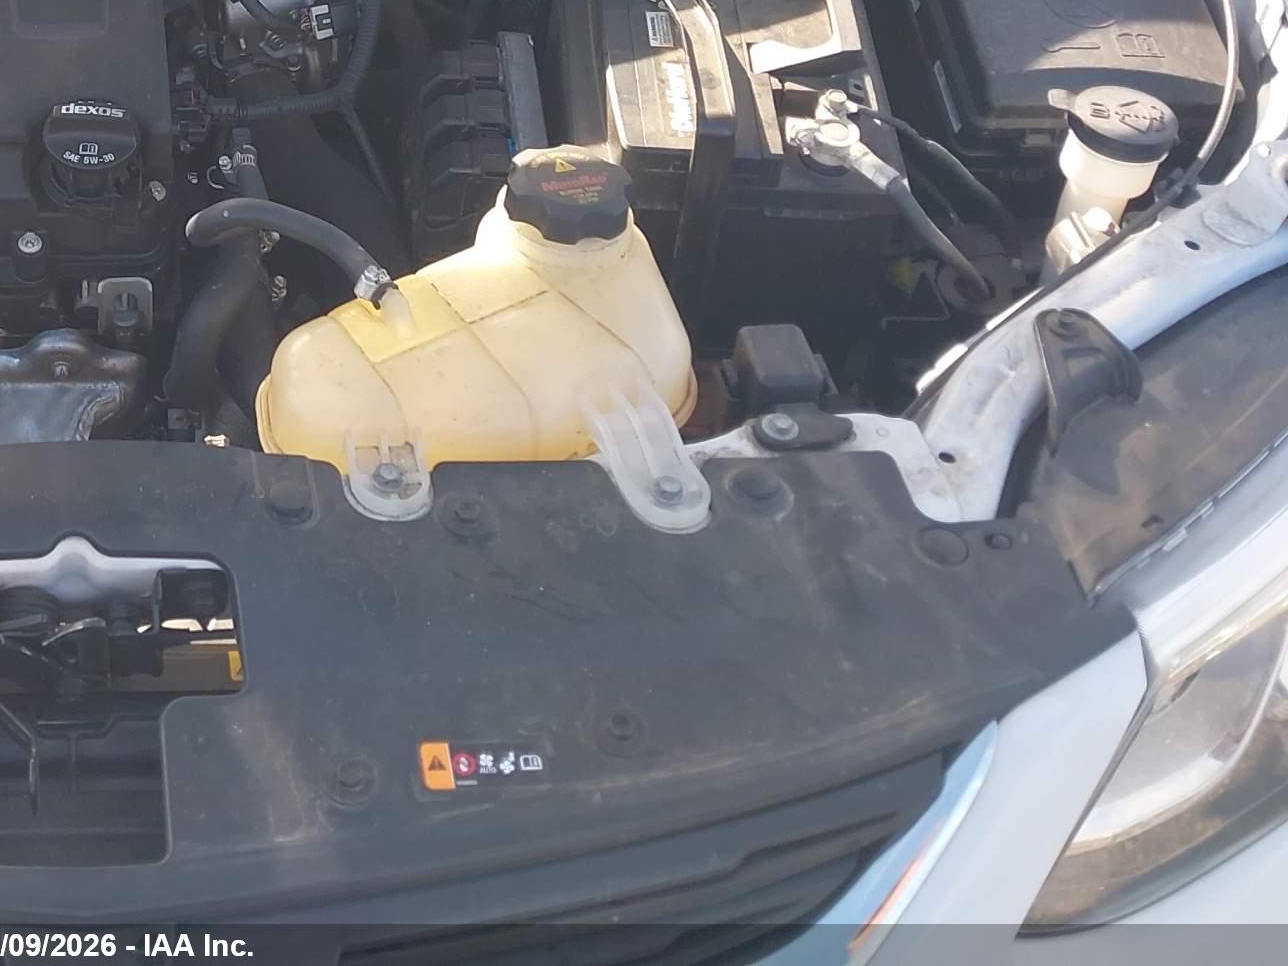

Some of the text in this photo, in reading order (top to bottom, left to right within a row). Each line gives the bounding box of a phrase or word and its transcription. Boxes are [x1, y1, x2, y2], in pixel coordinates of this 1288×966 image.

[61, 103, 127, 118] dexos
[63, 150, 115, 165] SAE 5W-30
